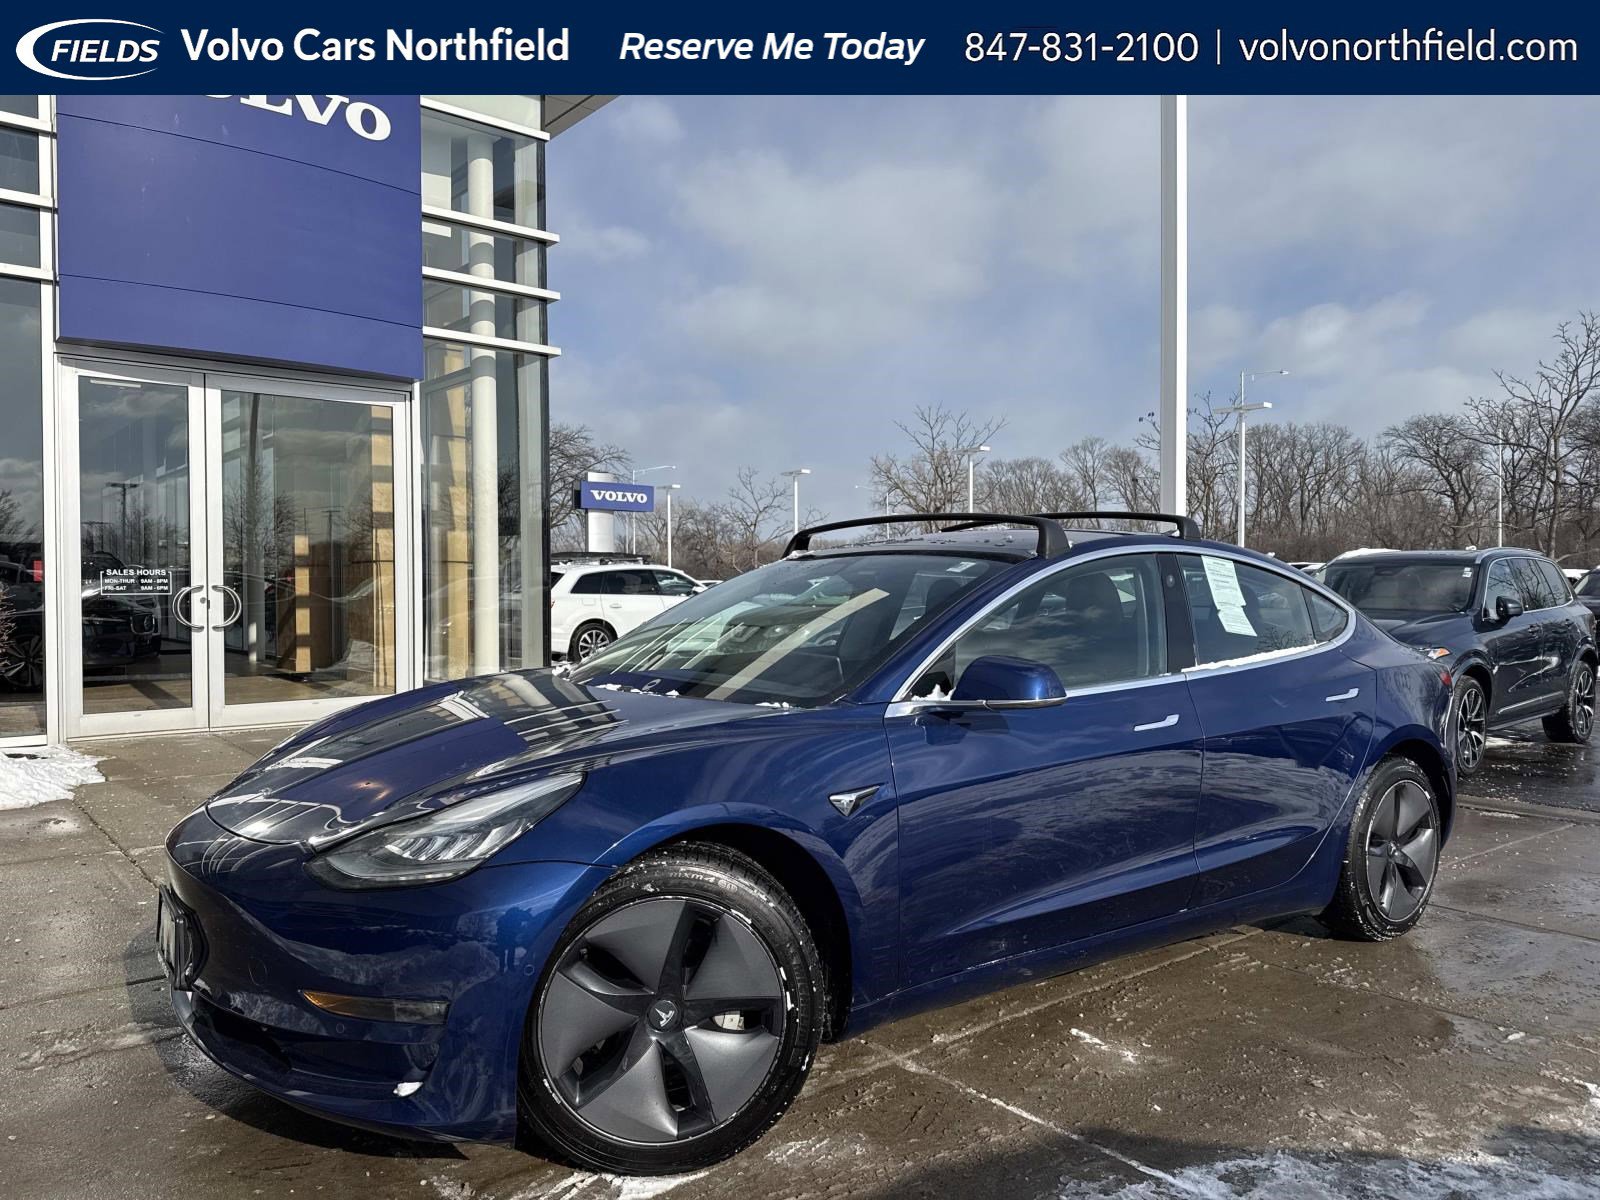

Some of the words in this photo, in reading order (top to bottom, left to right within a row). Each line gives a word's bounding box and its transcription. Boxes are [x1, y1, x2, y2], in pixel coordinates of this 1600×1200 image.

[590, 489, 648, 504] VOLVO
[106, 568, 135, 576] SALES
[136, 568, 167, 576] HOURS
